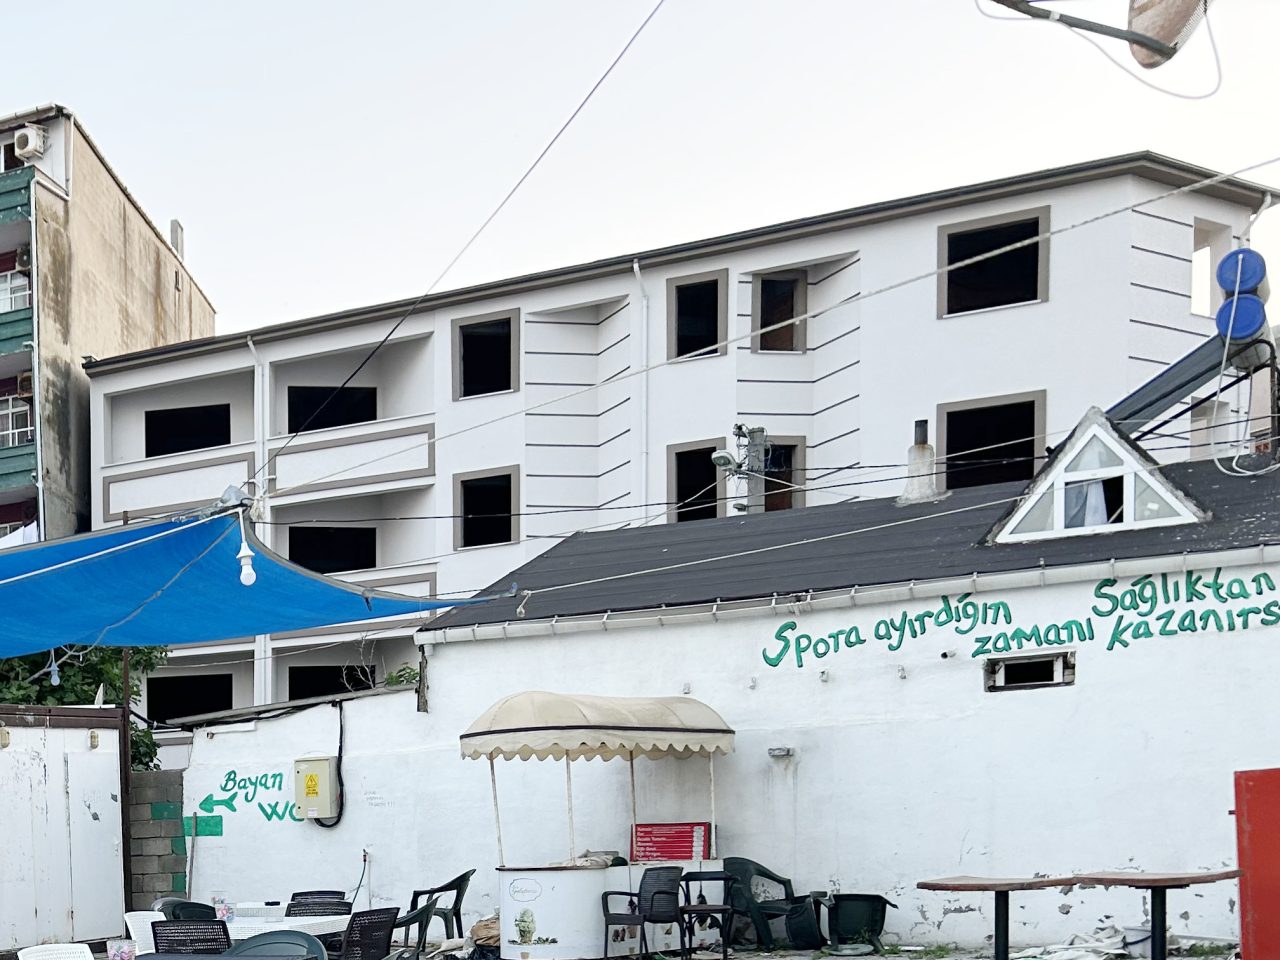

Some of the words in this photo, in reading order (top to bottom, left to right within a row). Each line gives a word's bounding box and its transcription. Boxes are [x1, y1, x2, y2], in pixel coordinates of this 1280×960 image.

[1091, 567, 1276, 617] Sağlıktan
[762, 620, 867, 668] Spora
[971, 617, 1095, 658] zamanı
[1106, 600, 1280, 651] kazanırs
[220, 769, 283, 803] Bayan
